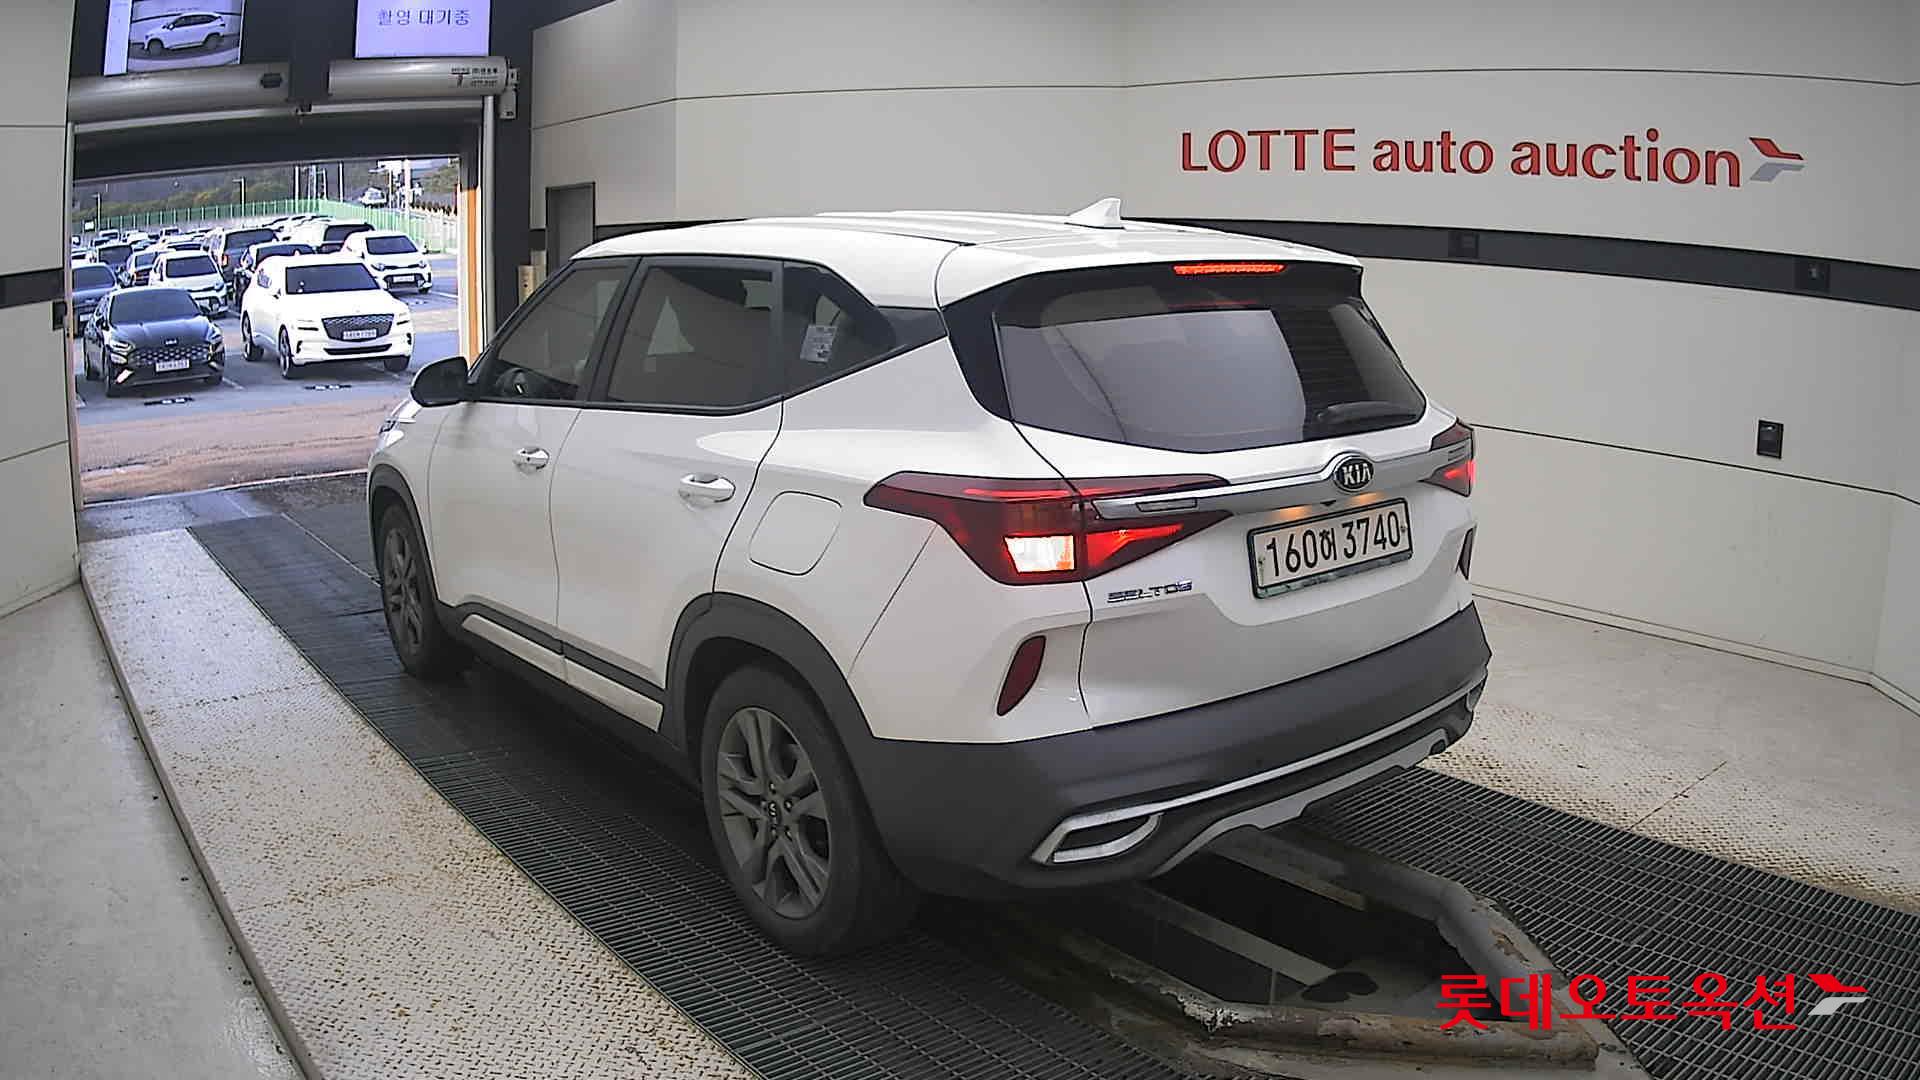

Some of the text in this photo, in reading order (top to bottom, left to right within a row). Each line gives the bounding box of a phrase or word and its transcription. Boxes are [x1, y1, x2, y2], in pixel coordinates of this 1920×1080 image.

[1180, 128, 1742, 187] LOTTE auto auction
[1341, 461, 1374, 485] KIA
[1266, 510, 1401, 577] 160허 3740
